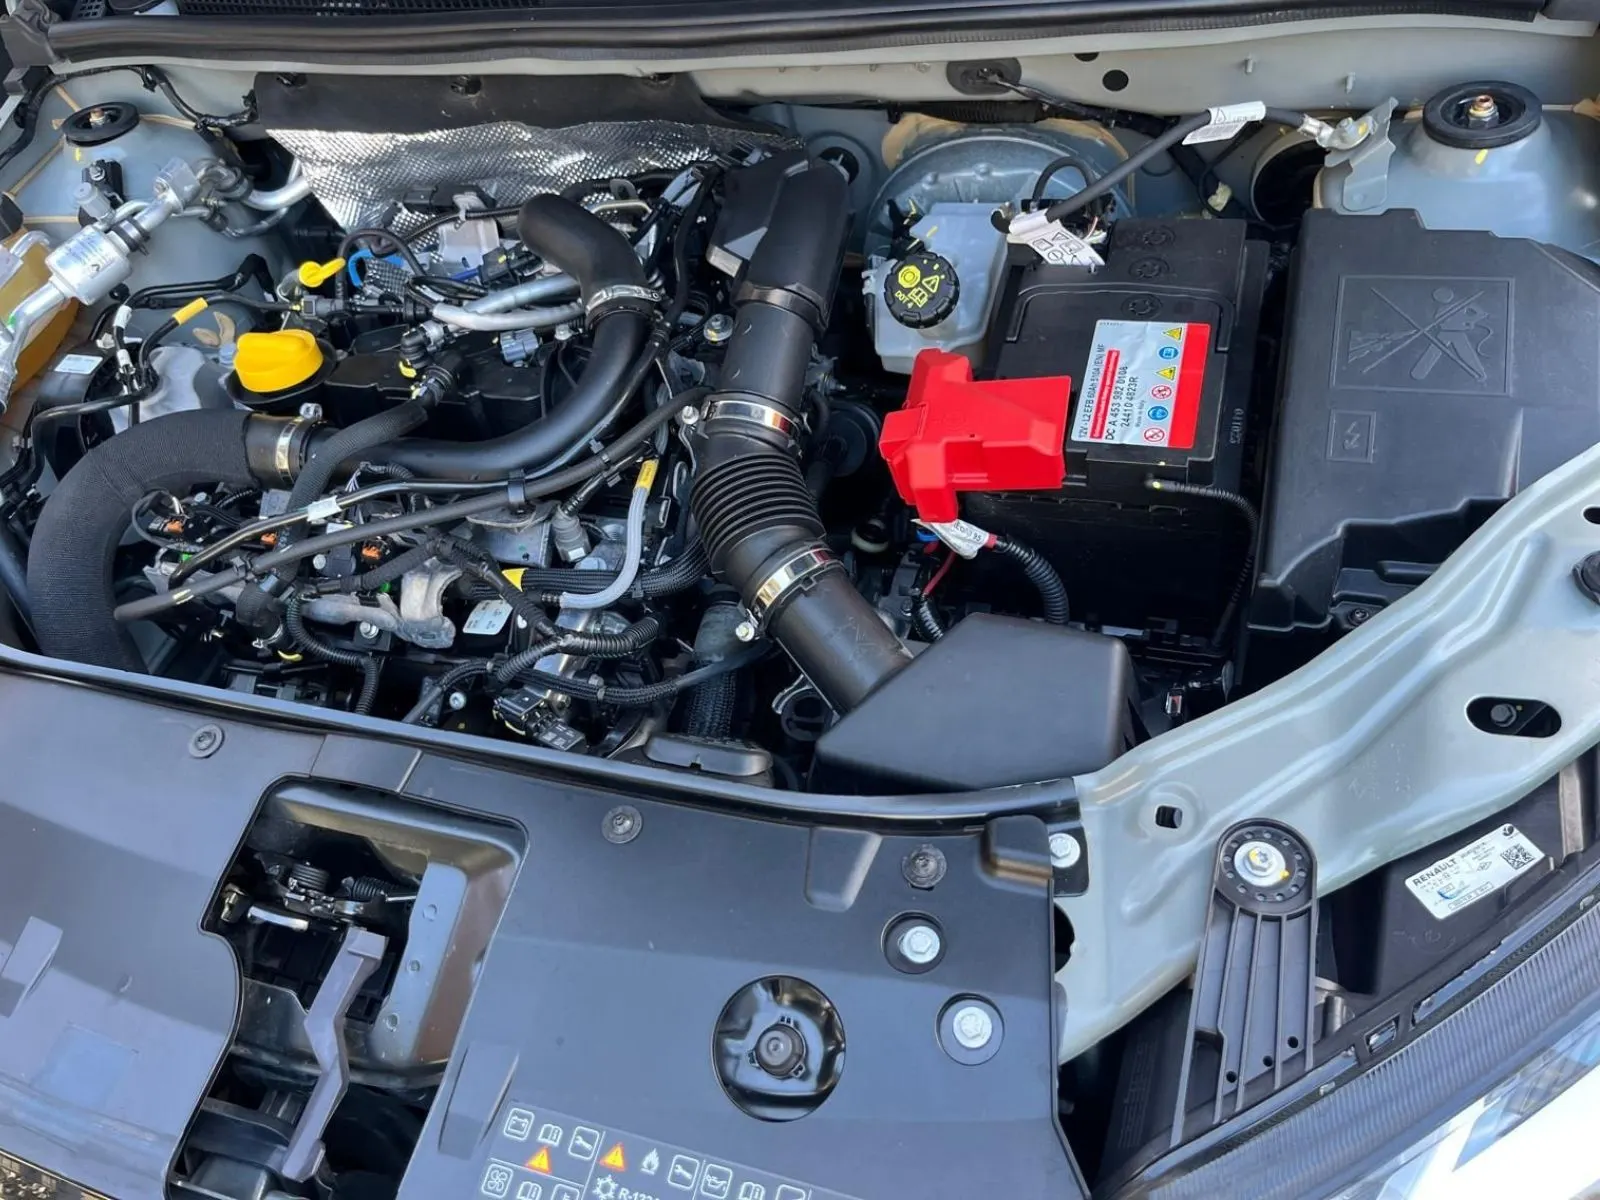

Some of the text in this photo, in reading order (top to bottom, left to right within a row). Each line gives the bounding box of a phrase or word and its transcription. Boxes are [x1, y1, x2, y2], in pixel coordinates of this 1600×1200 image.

[895, 290, 909, 303] DOT
[1086, 382, 1098, 398] 60Ah
[1113, 386, 1124, 400] 982
[1083, 399, 1095, 412] EFB
[1120, 376, 1139, 427] 24410 4823R
[1110, 402, 1121, 418] 453
[1078, 425, 1089, 438] 12V
[1105, 429, 1115, 440] DC
[1412, 858, 1458, 887] RENAULT
